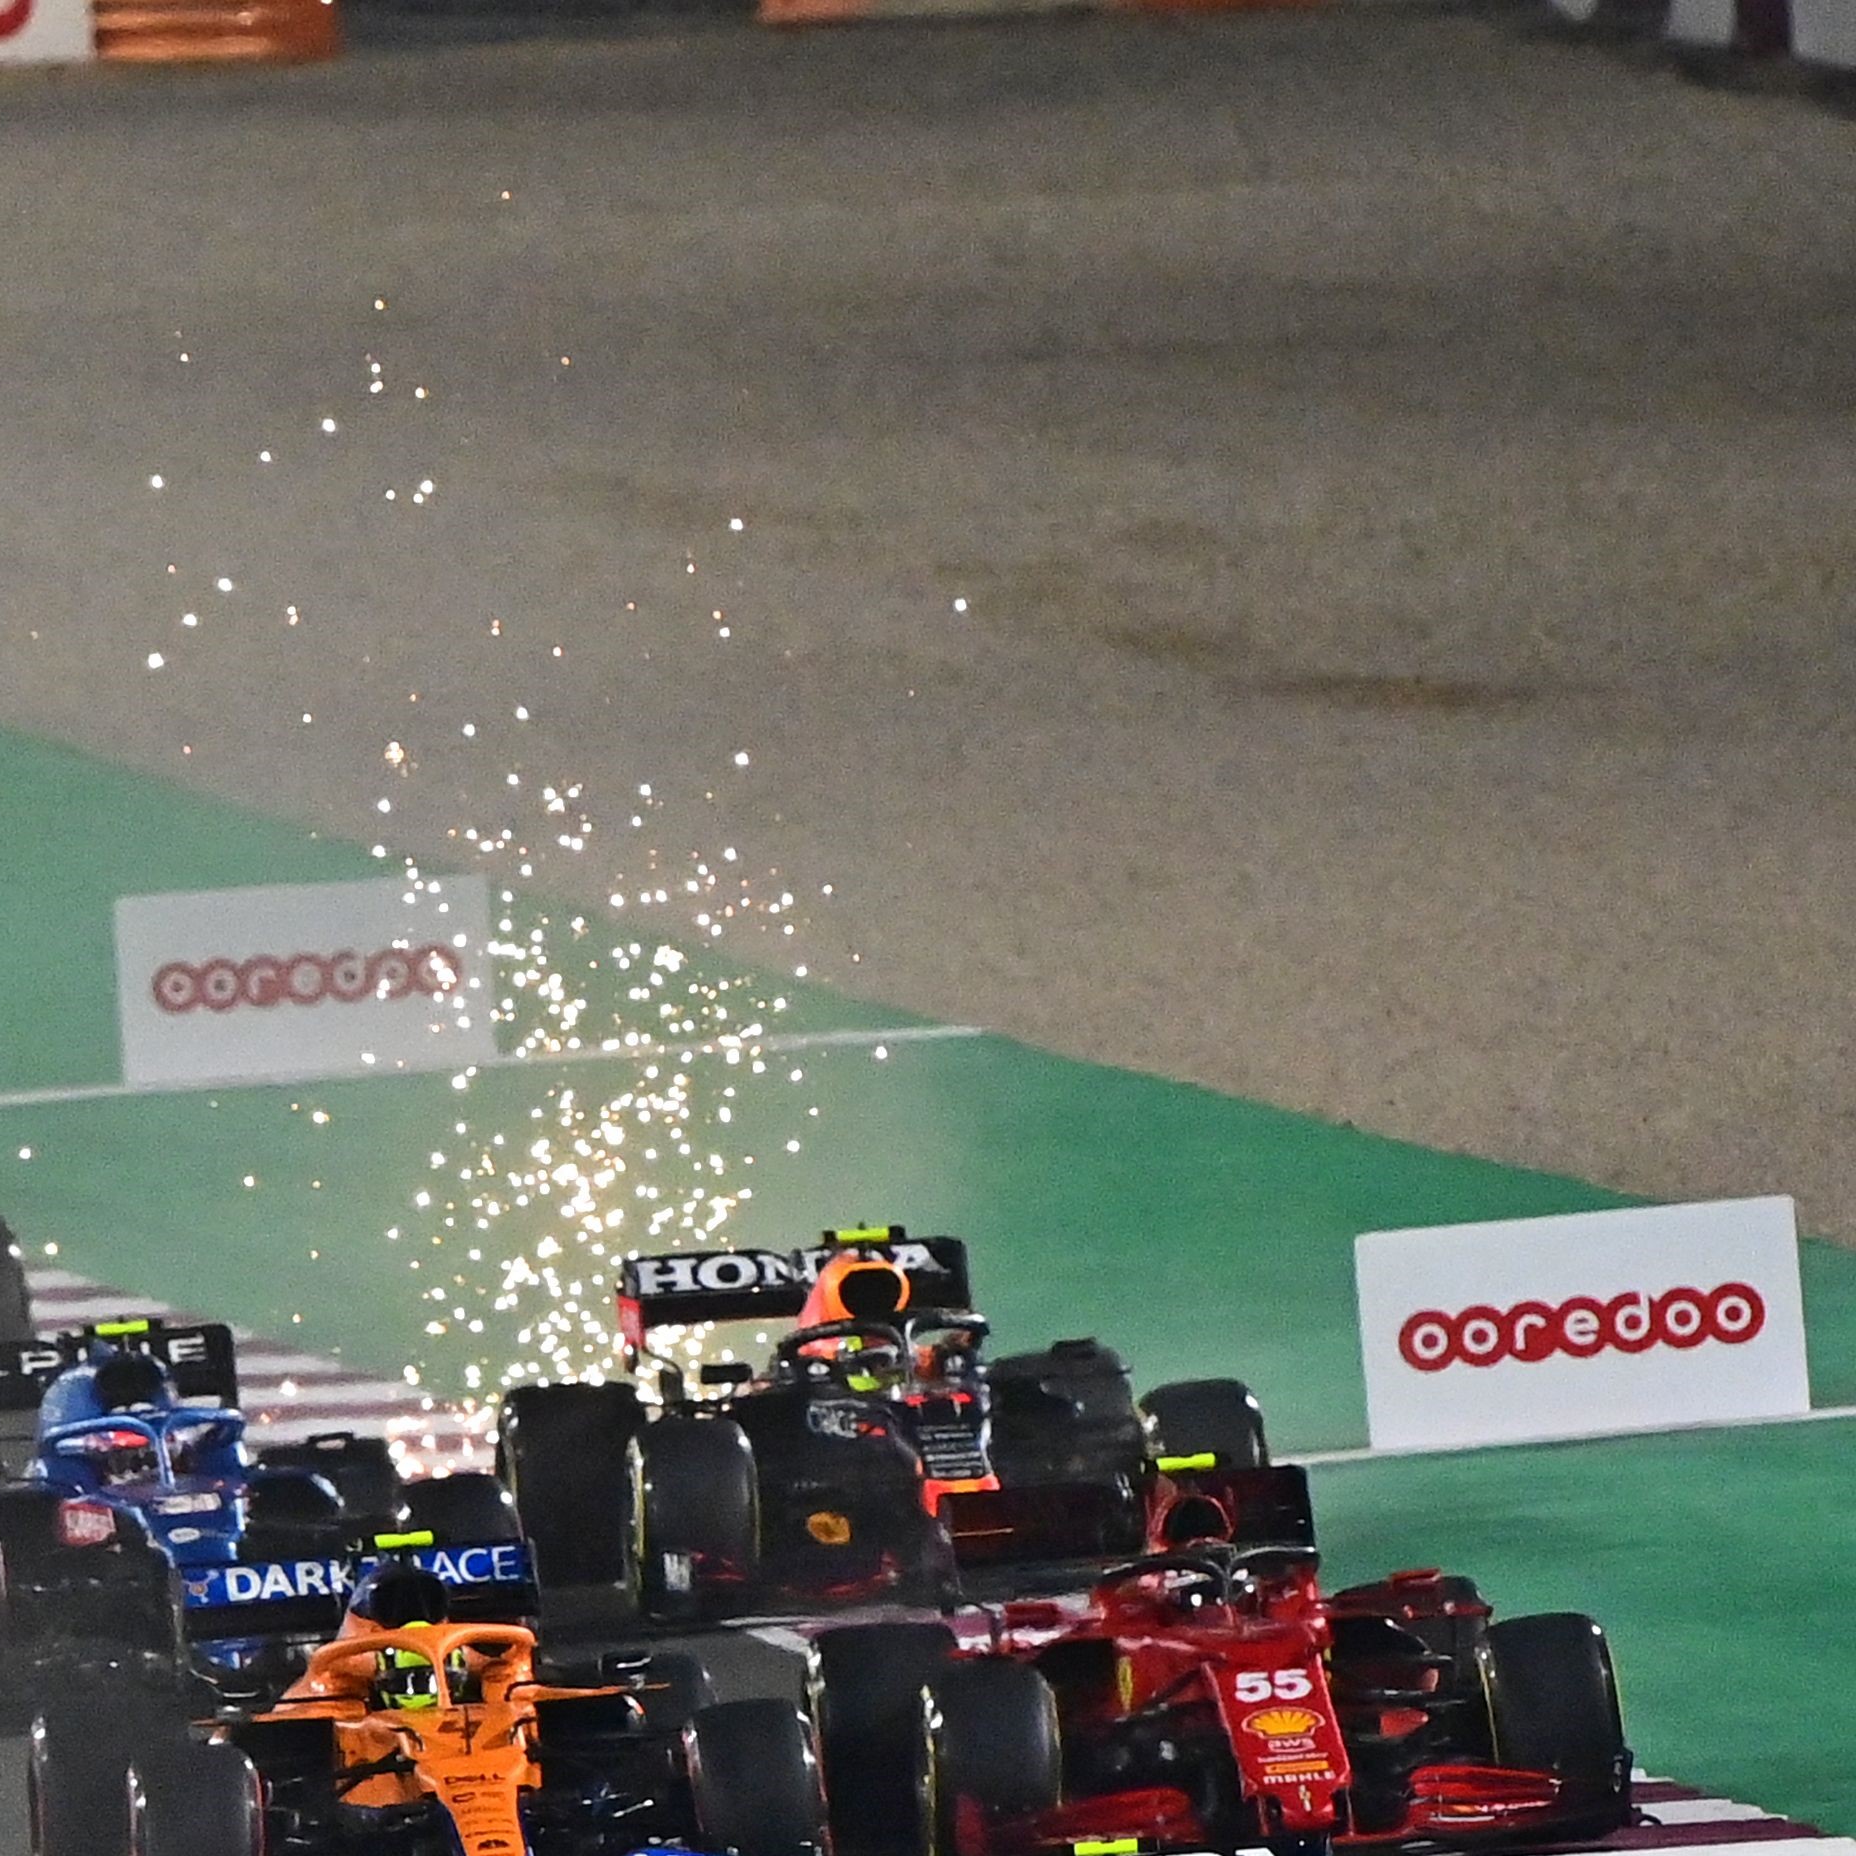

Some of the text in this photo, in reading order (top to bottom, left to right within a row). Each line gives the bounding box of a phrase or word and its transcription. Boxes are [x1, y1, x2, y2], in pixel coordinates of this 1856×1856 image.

[638, 1243, 949, 1295] HONA
[1401, 1285, 1763, 1369] ooredoo
[224, 1545, 519, 1601] DARKACE
[1235, 1668, 1313, 1703] 55
